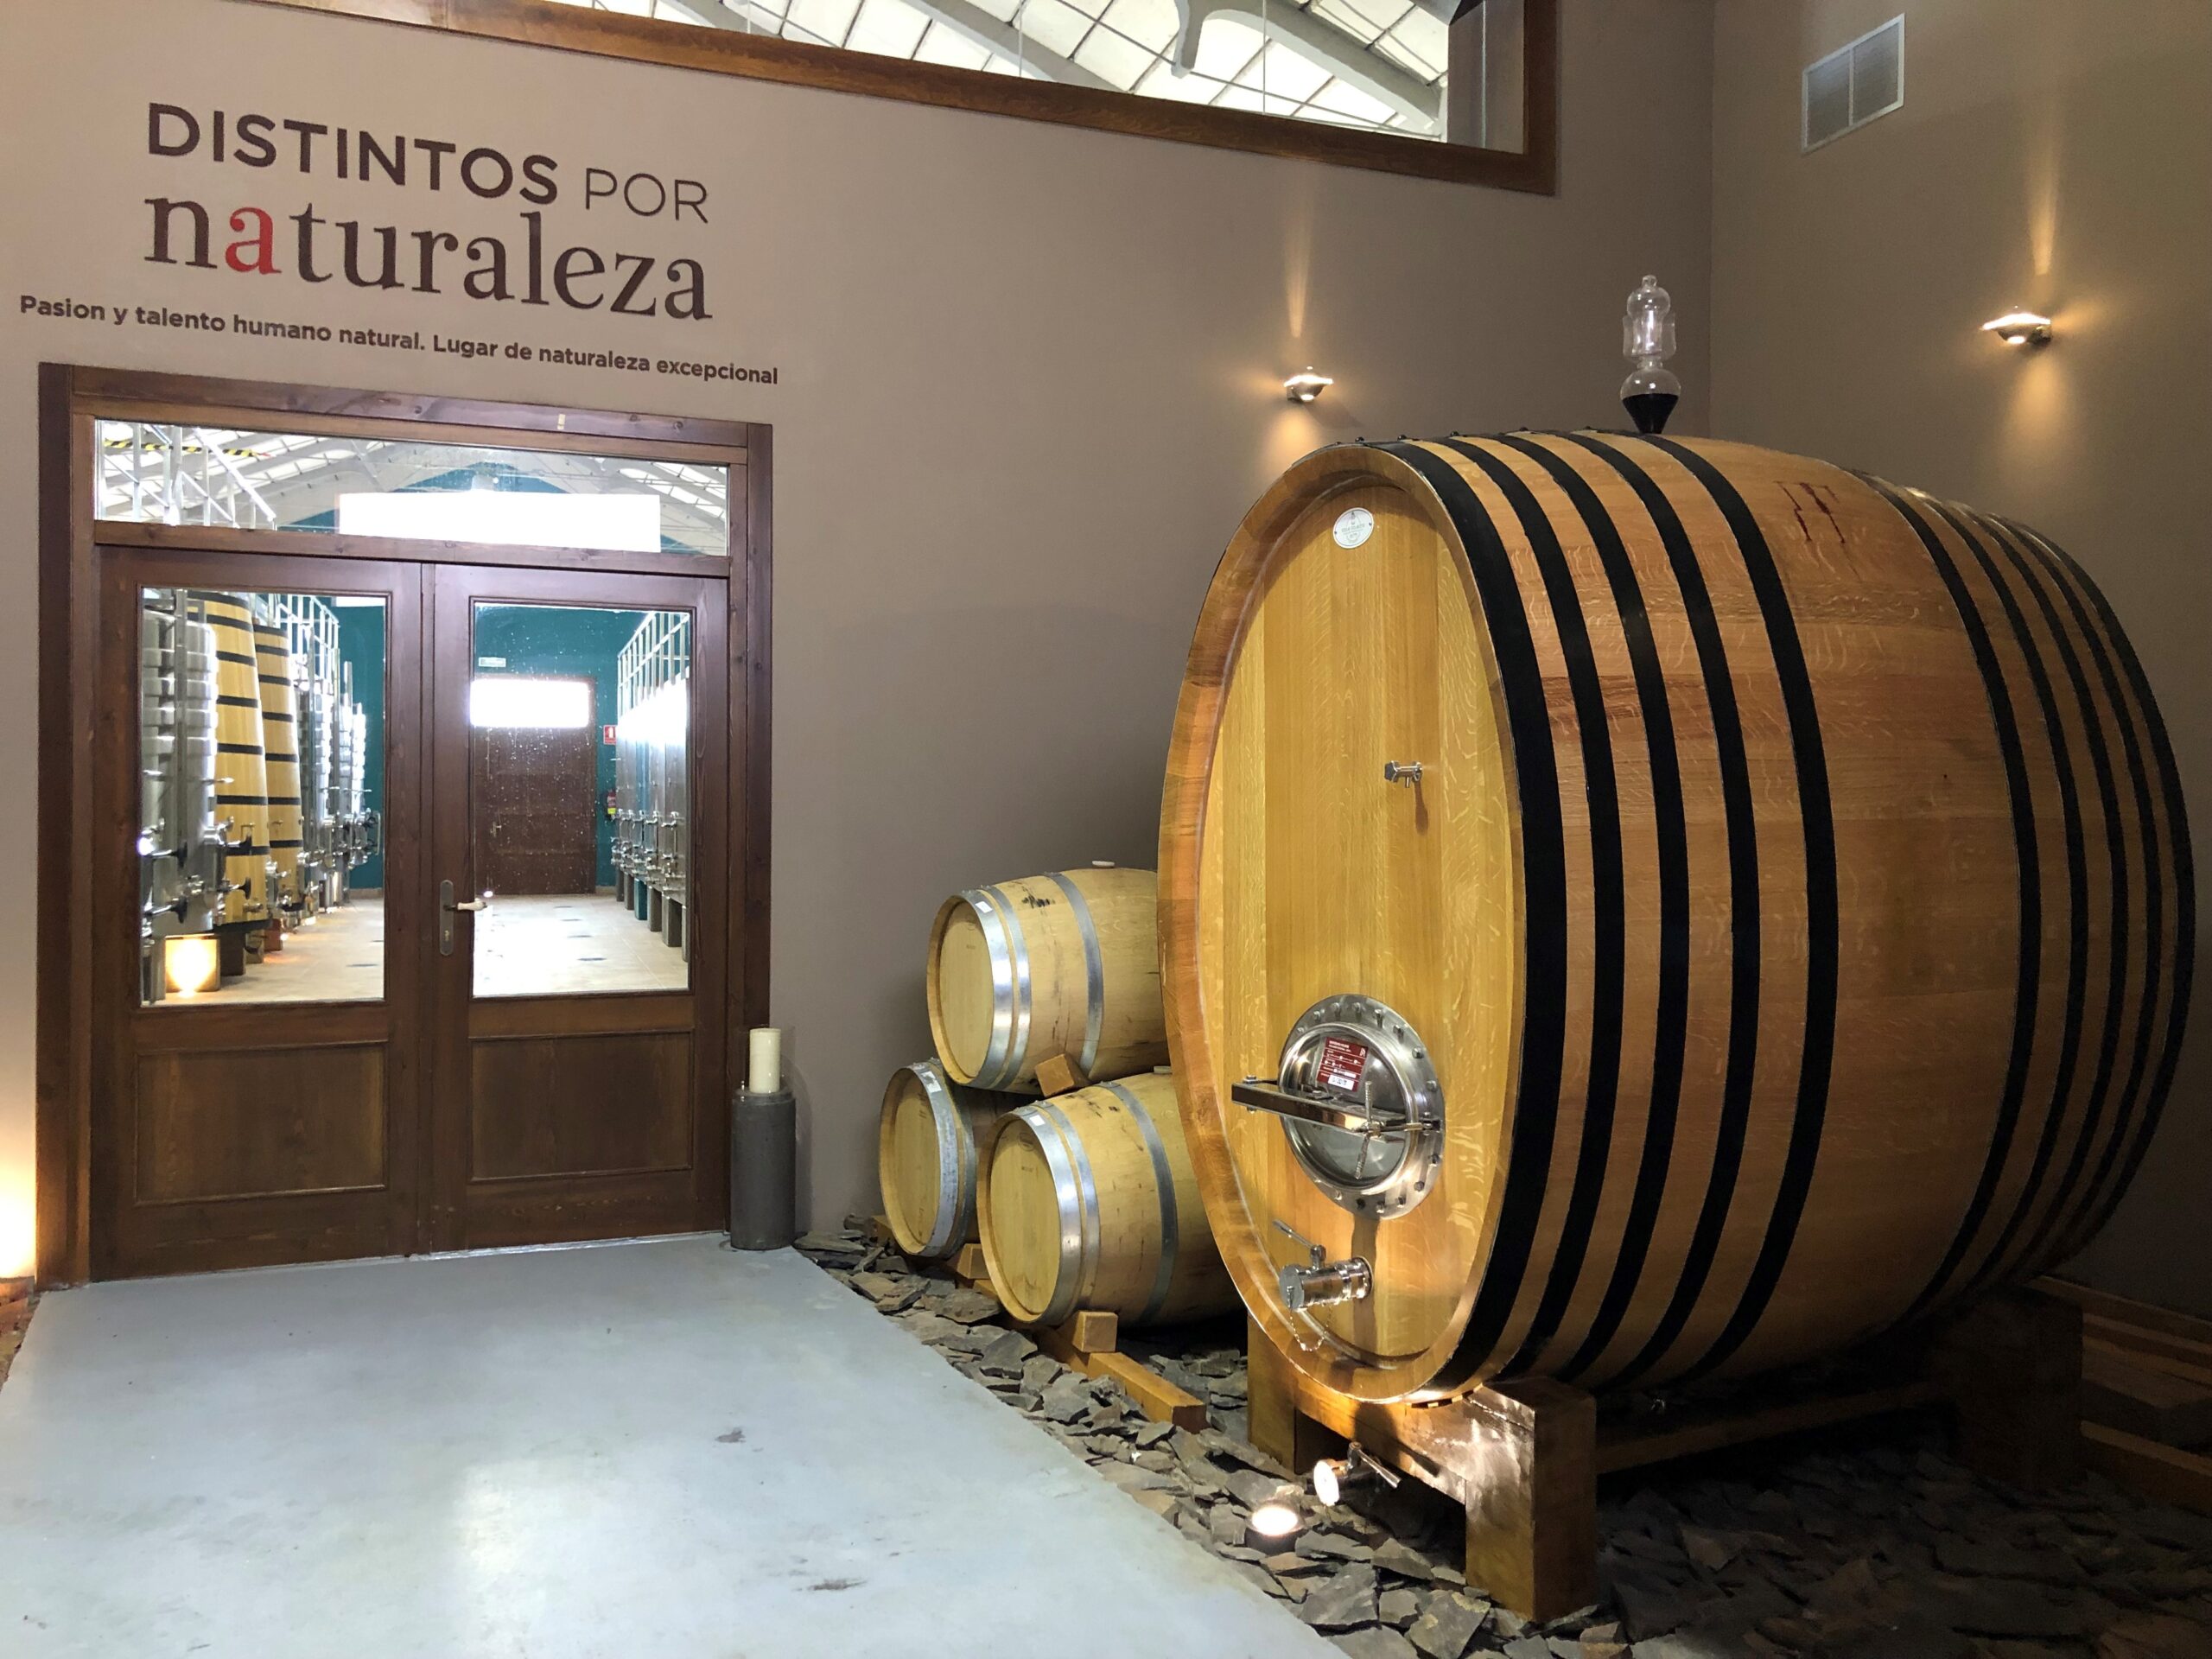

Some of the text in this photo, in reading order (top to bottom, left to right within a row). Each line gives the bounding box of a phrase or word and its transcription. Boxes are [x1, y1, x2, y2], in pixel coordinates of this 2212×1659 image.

[148, 101, 709, 225] DISTINTOS POR
[143, 196, 714, 321] naturaleza
[20, 294, 779, 385] Pasion y talento humano natural. Lugar de naturaleza excepcional
